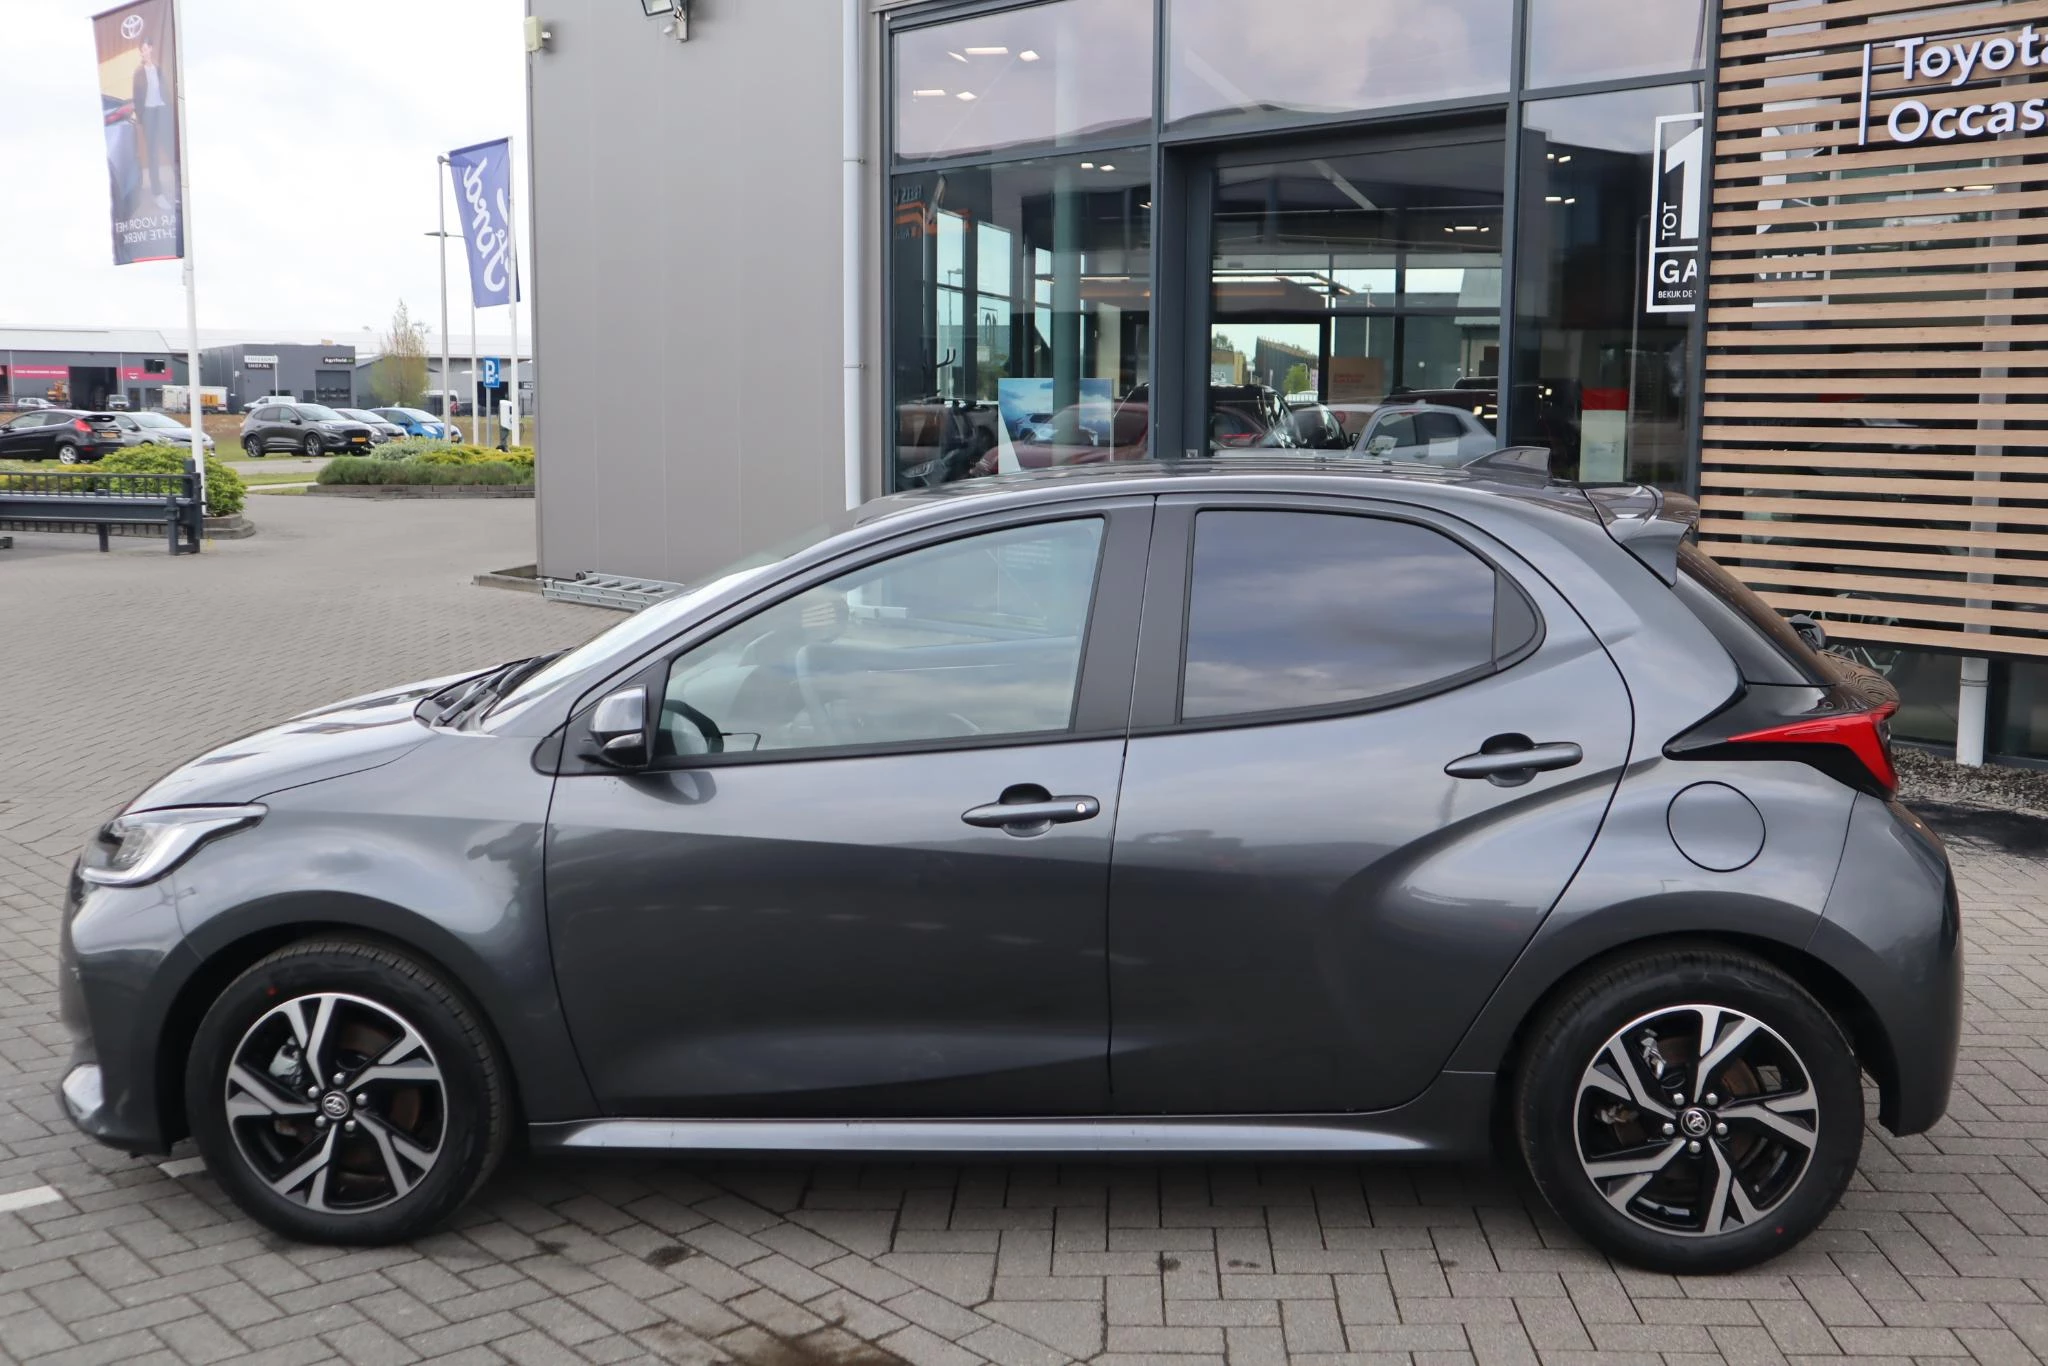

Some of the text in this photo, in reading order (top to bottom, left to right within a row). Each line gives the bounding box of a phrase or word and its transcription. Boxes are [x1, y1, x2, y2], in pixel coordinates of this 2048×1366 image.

[1894, 25, 2048, 86] Toyot
[1662, 201, 1678, 240] TOT
[1658, 290, 1682, 299] BEKIJK
[1682, 289, 1693, 298] DE
